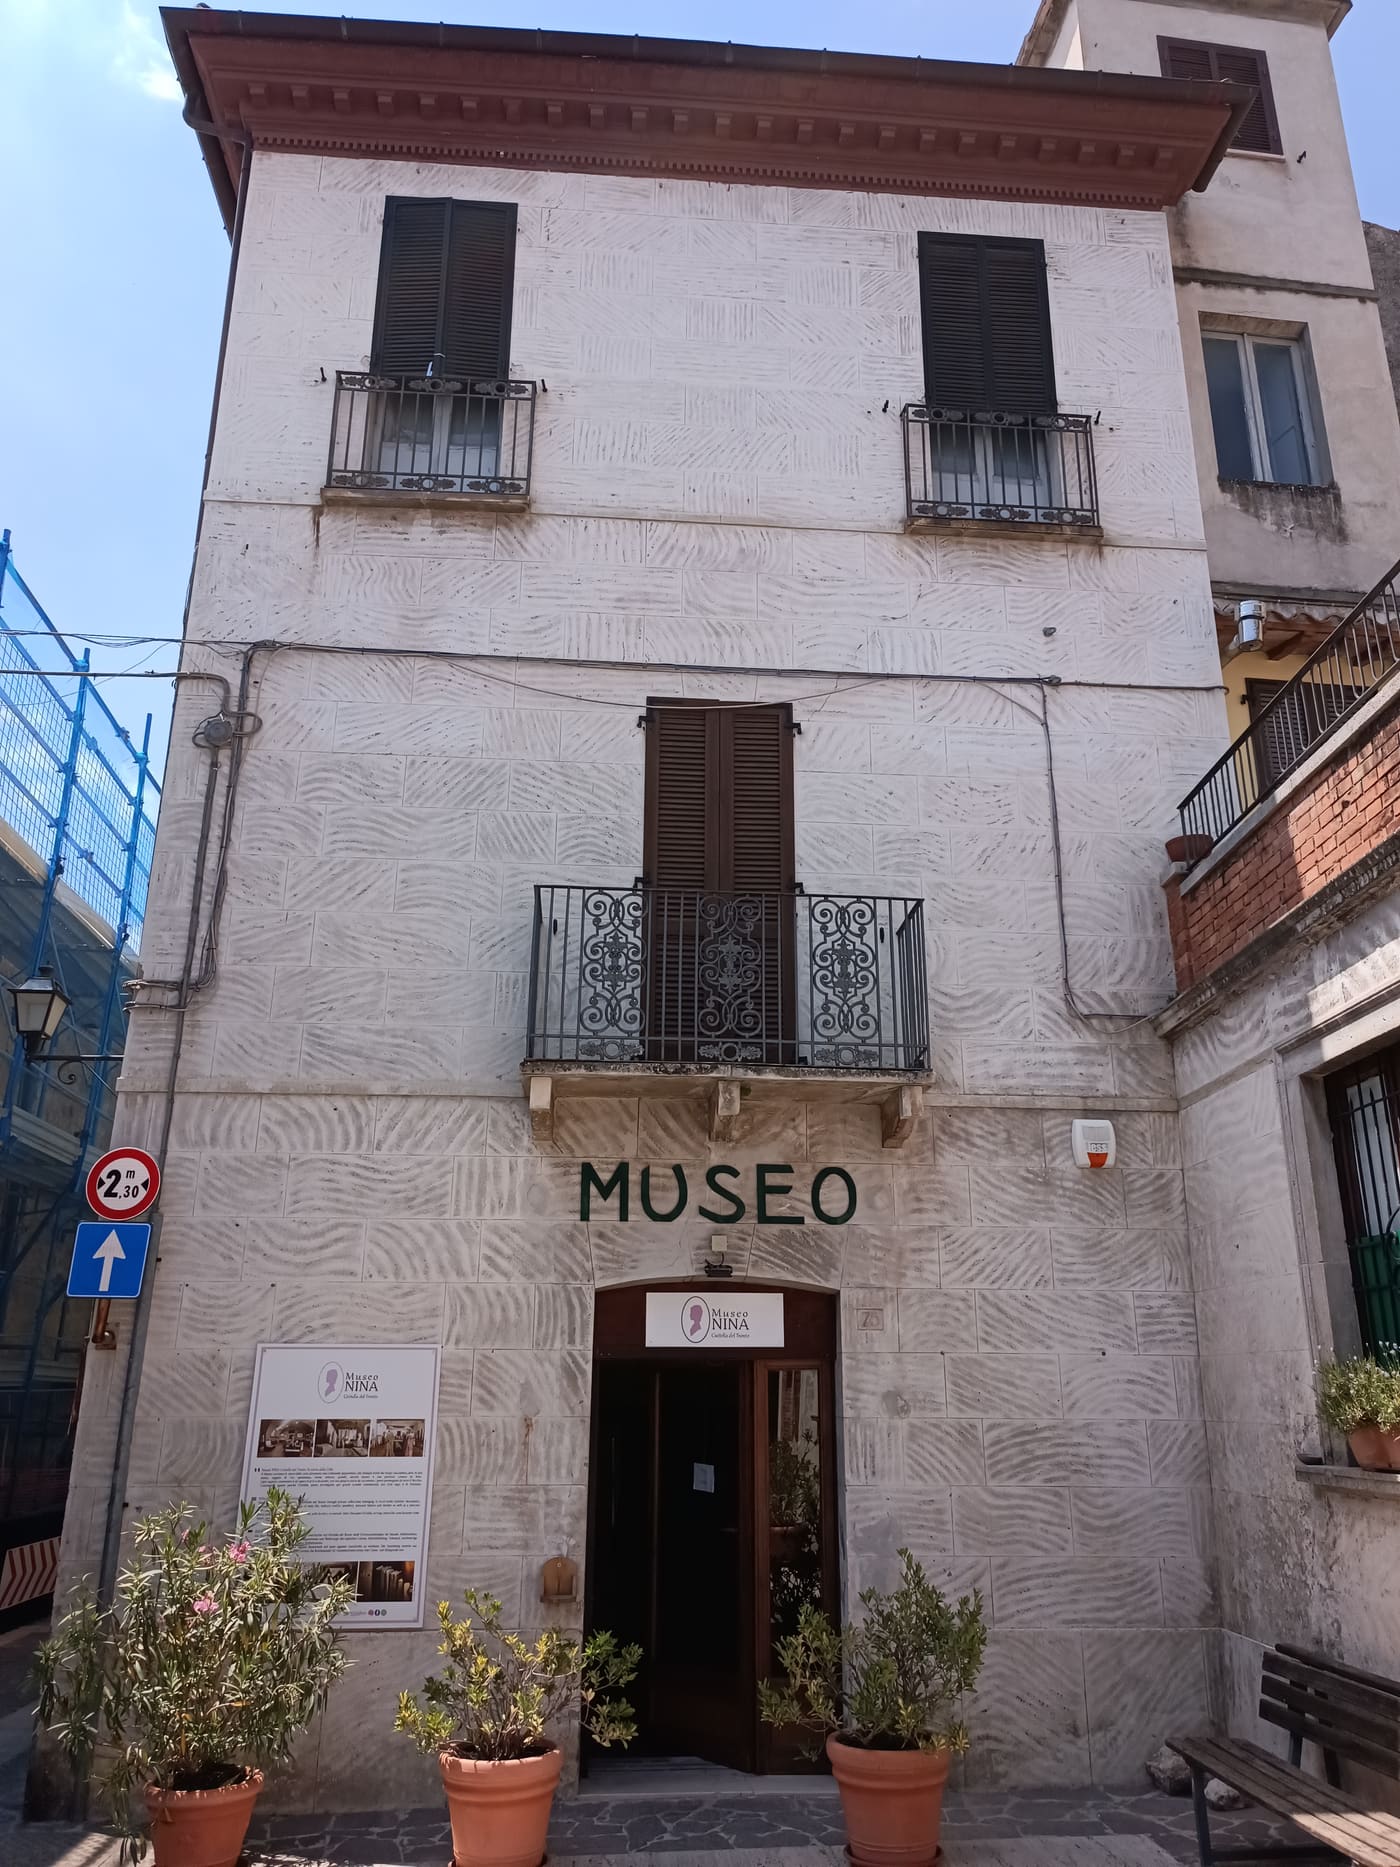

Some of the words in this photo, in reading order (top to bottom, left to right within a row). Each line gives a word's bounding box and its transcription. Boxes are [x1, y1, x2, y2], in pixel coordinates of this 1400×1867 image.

[125, 1170, 135, 1179] m
[580, 1162, 857, 1225] MUSEO
[711, 1308, 749, 1318] Museo
[711, 1318, 750, 1331] NINA
[345, 1372, 379, 1381] Museo
[344, 1380, 379, 1392] NINA
